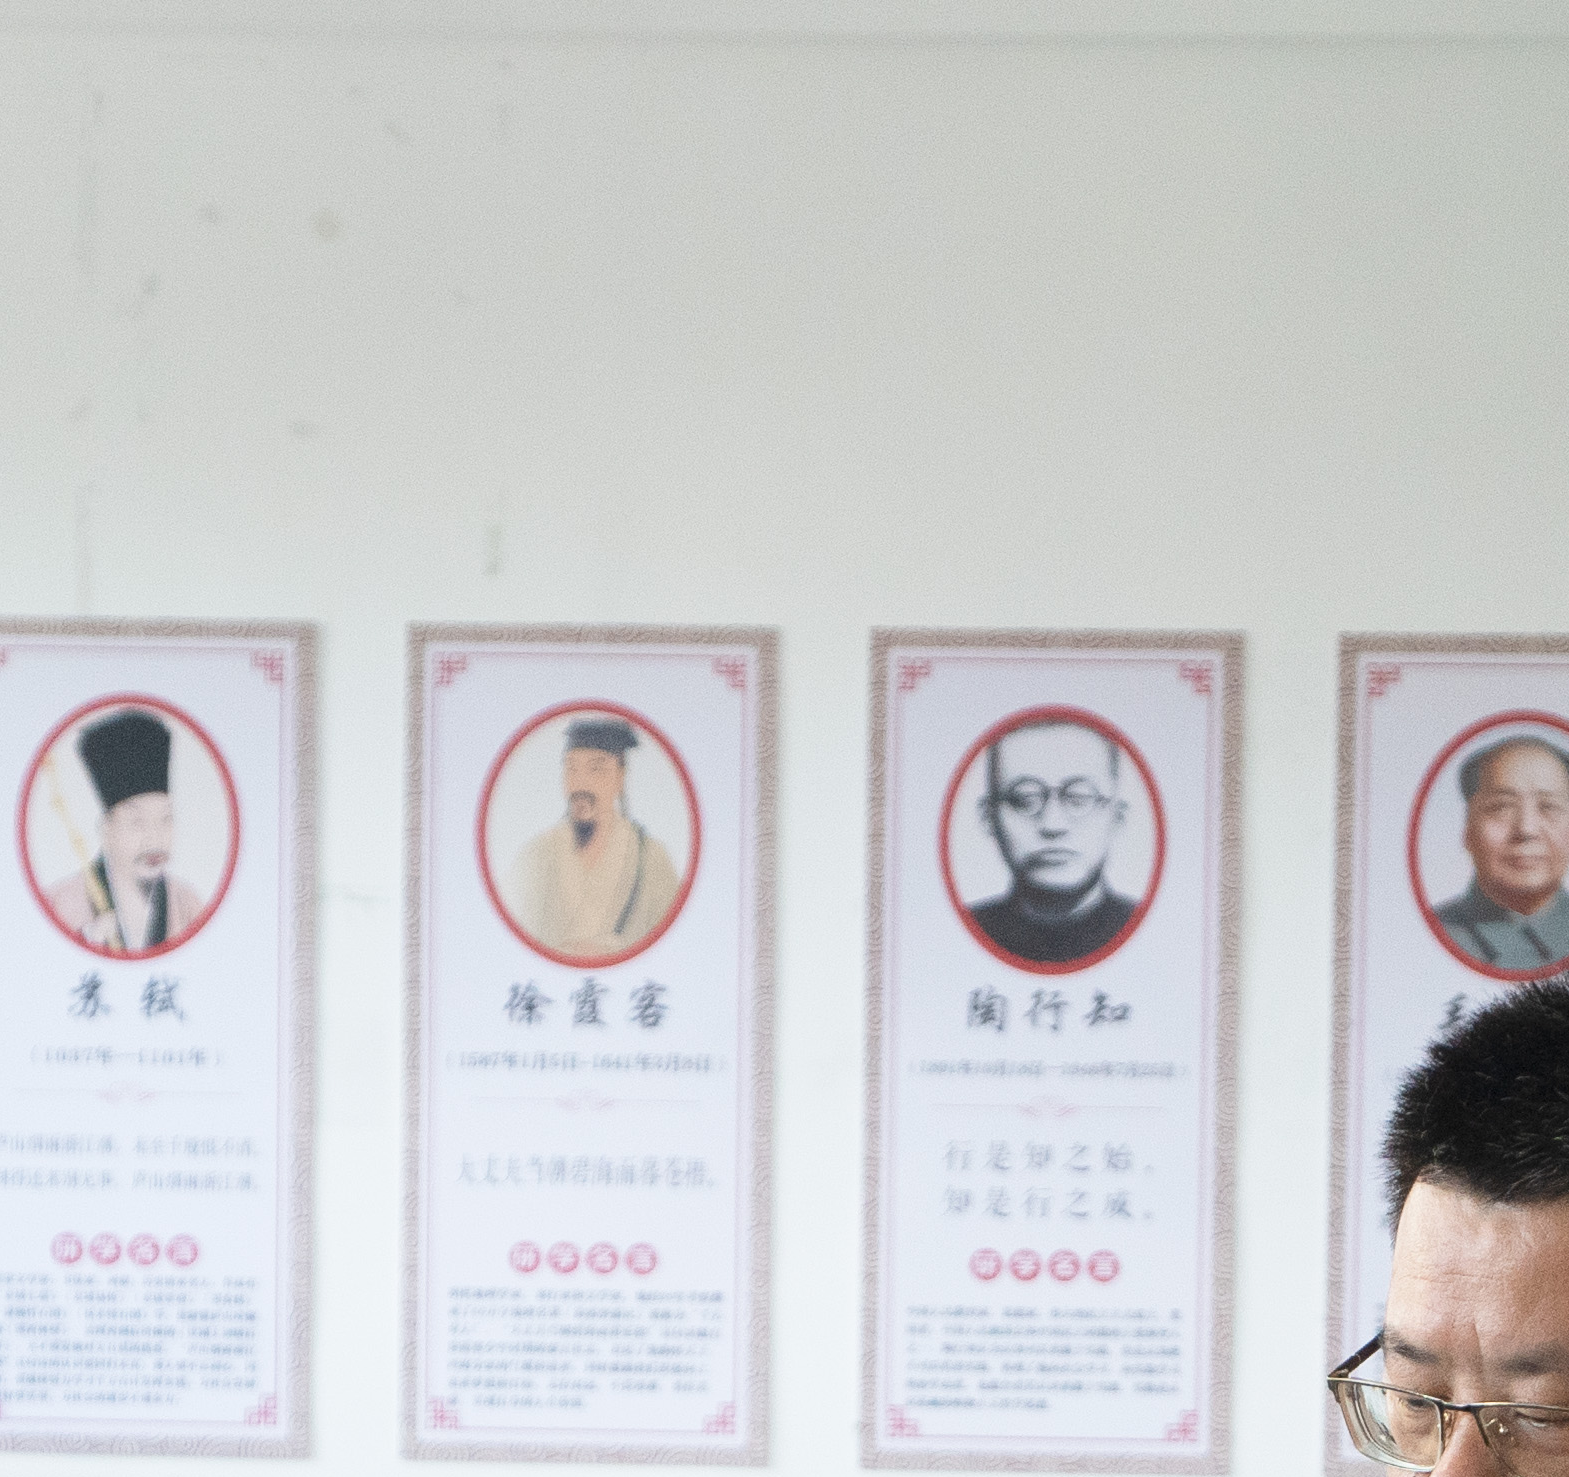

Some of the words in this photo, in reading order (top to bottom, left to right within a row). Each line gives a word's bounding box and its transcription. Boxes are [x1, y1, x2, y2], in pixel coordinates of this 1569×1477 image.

[69, 971, 187, 1022] 苏轼
[503, 975, 669, 1031] 徐霞客
[967, 986, 1134, 1034] 陶行知
